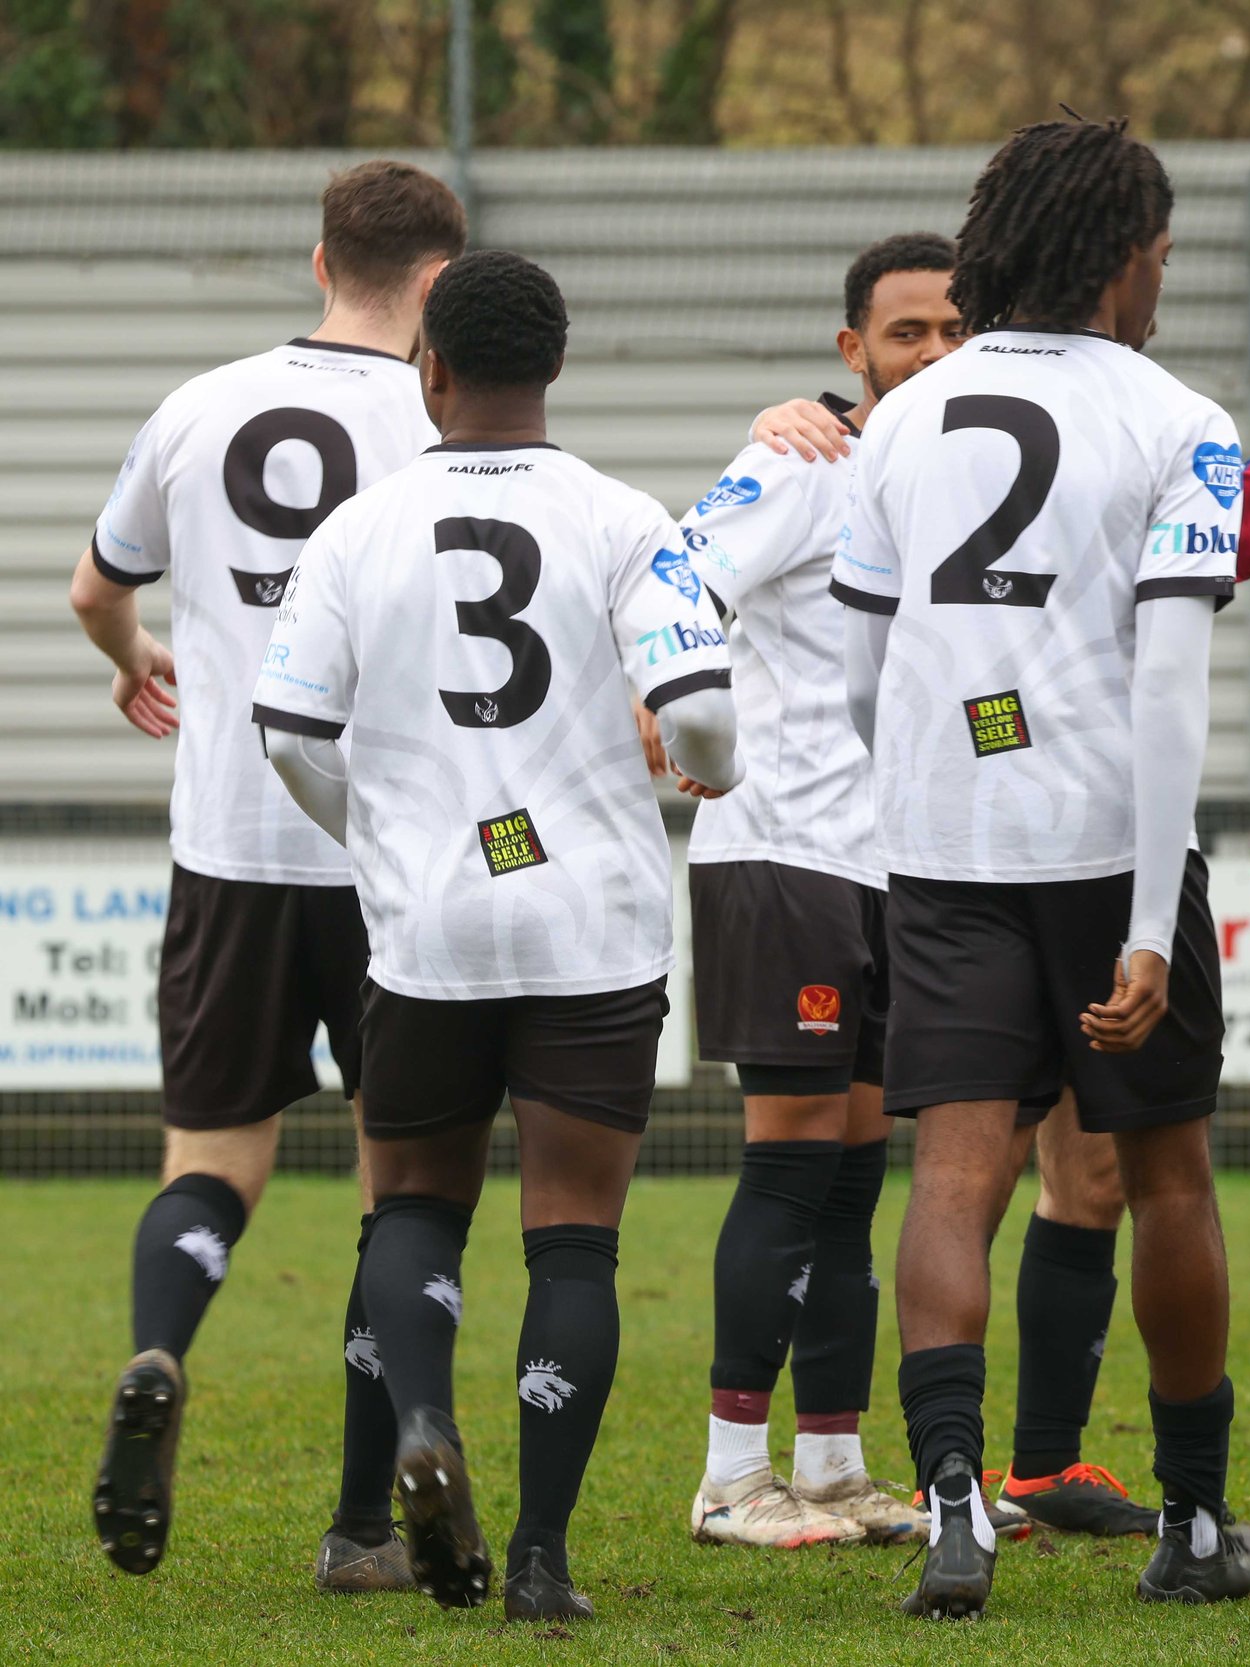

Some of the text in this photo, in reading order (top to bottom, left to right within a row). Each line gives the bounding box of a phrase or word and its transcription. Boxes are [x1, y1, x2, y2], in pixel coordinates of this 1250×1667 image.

[979, 345, 1042, 355] BALHAM
[447, 463, 535, 475] BALHAM FC
[1209, 465, 1242, 486] NHS
[223, 407, 357, 607] 9
[931, 394, 1060, 609] 2
[434, 516, 552, 730] 3
[977, 696, 1019, 718] BIG
[975, 723, 1016, 743] SELF
[490, 815, 529, 839] BIG
[486, 833, 526, 850] YELLOW
[490, 841, 530, 863] SELF
[494, 854, 535, 871] STORAGE
[72, 889, 168, 921] LAN
